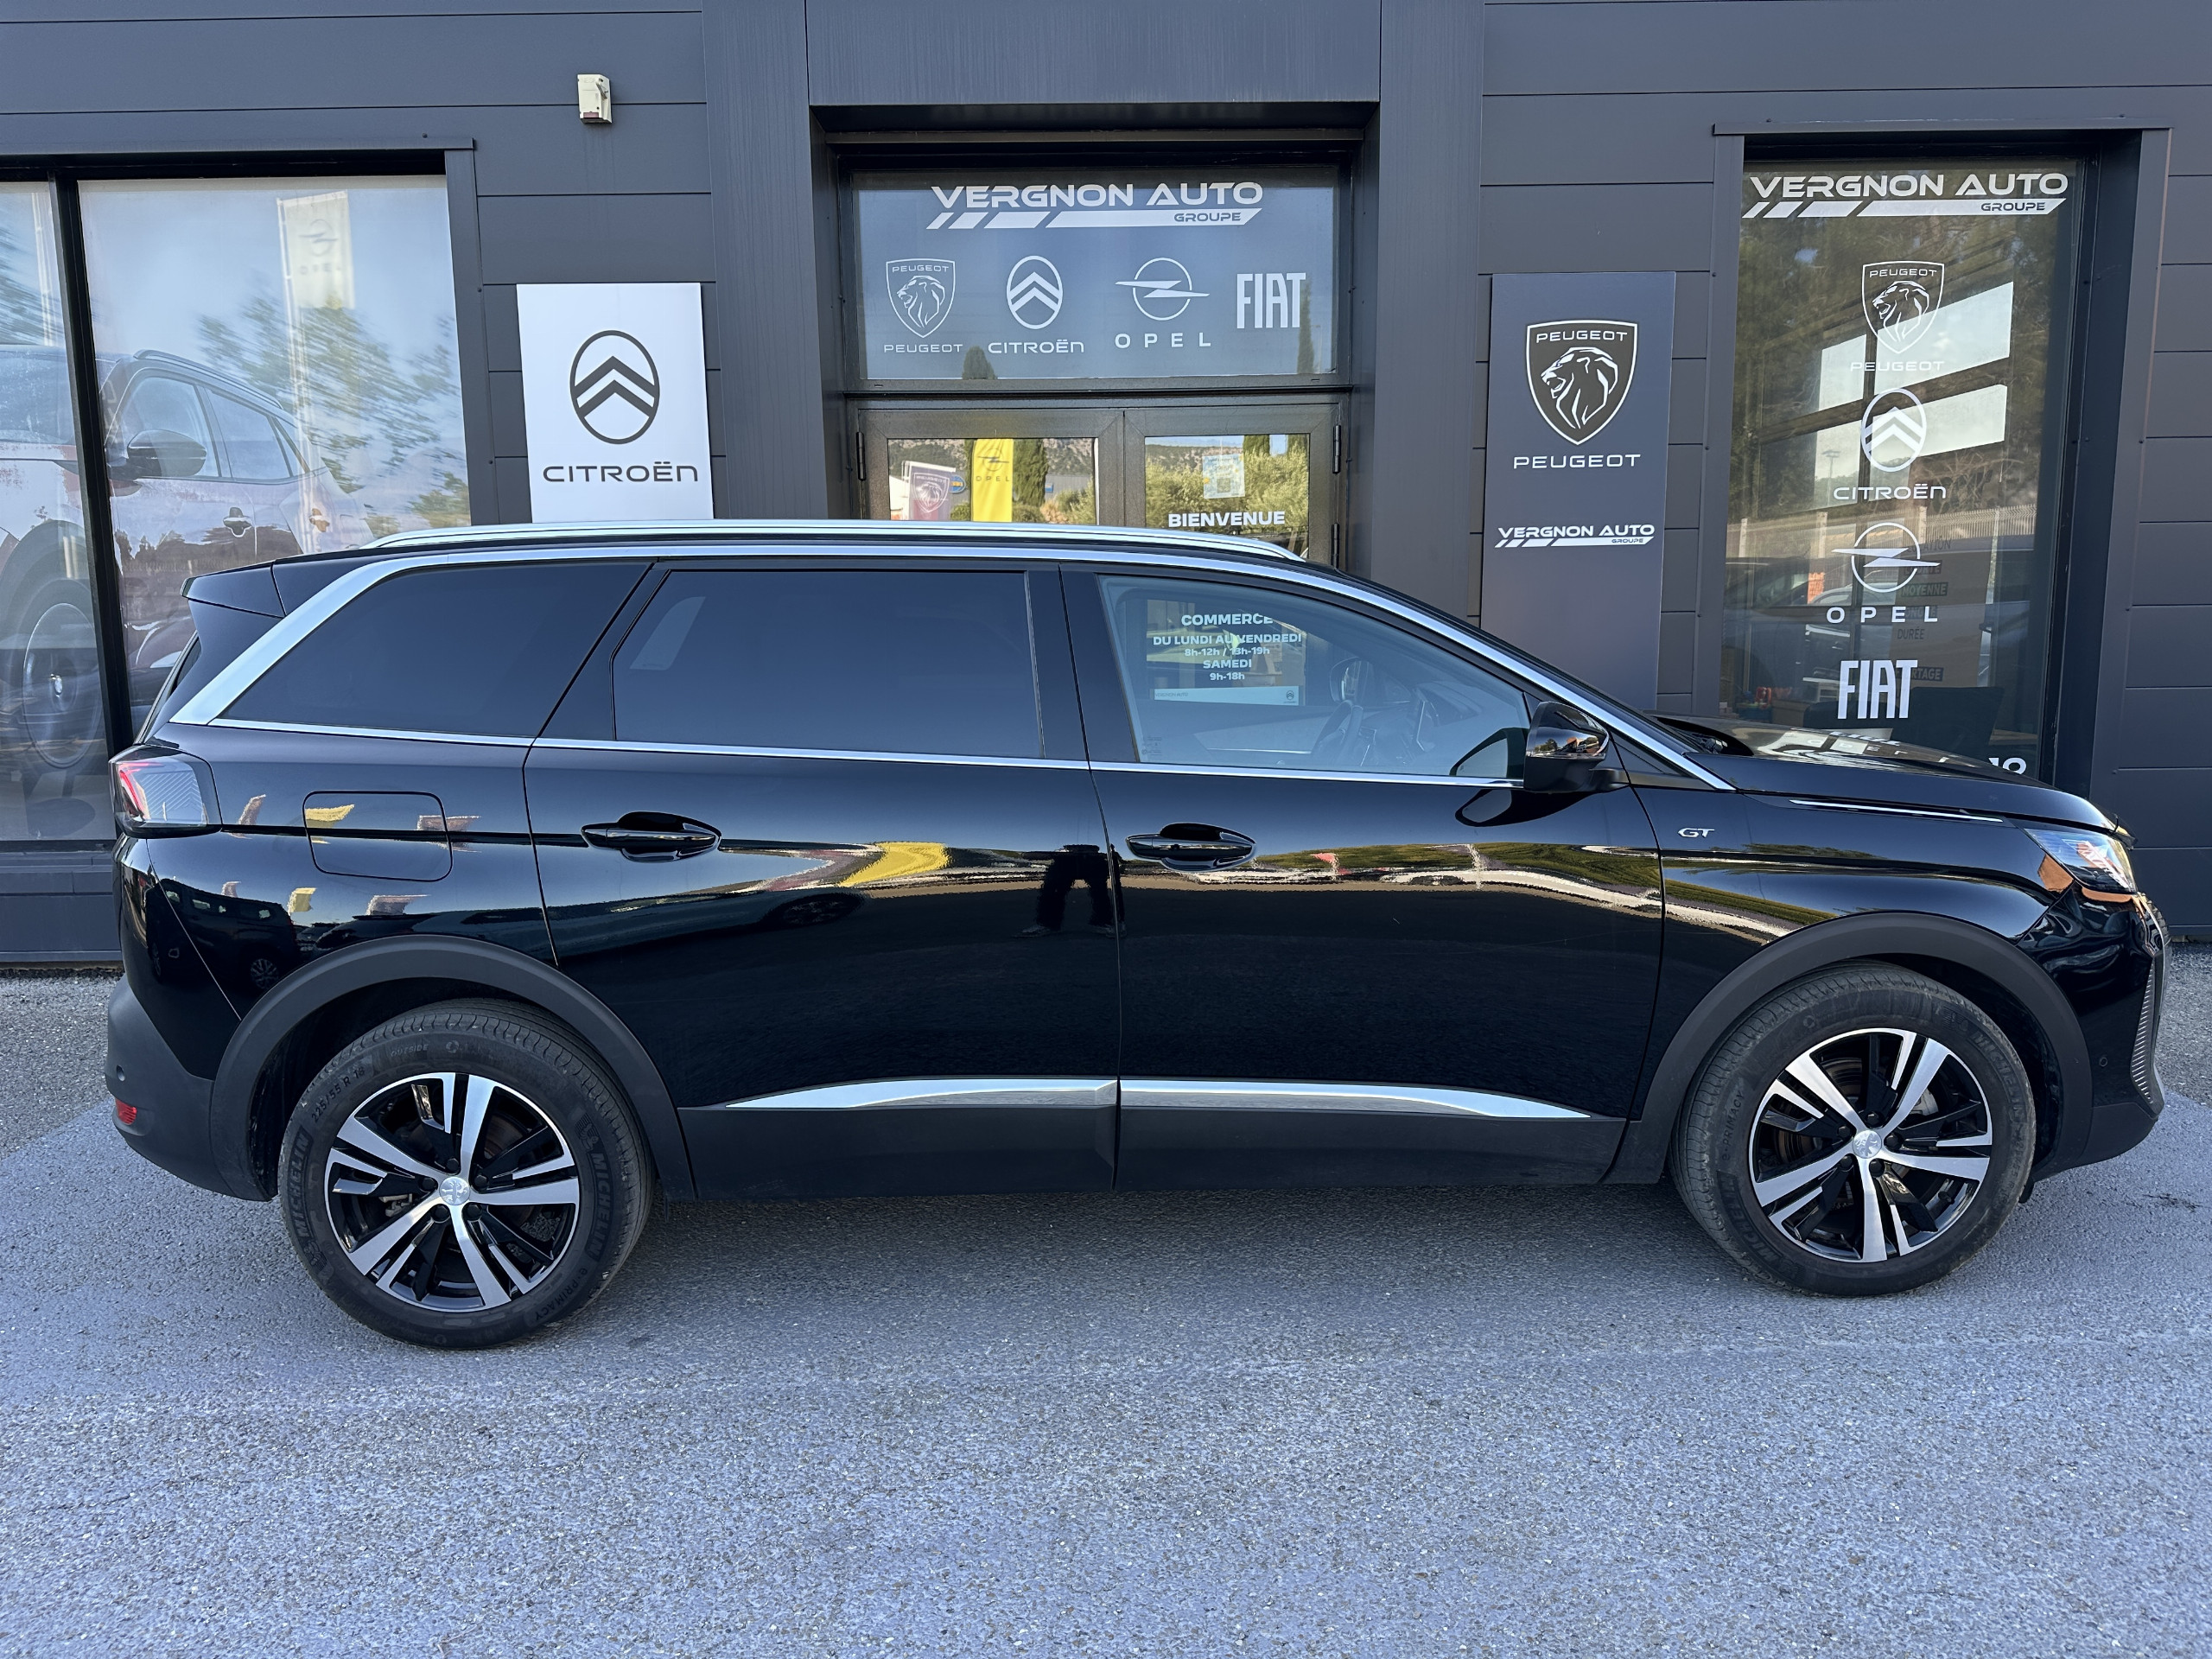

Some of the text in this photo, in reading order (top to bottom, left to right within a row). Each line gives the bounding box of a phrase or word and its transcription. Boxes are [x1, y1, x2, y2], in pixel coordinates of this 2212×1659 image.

[1750, 173, 2069, 199] VERGNON AUTO
[931, 182, 1263, 208] VERGNON AUTO
[1980, 201, 2046, 212] GROUPE
[1173, 212, 1242, 222] GROUPE
[892, 264, 950, 274] PEUGEOT
[1869, 268, 1937, 277] PEUGEOT
[1236, 272, 1306, 329] FIAT
[1115, 332, 1211, 349] OPEL
[1536, 330, 1628, 343] PEUGEOT
[883, 344, 963, 353] PEUGEOT
[988, 339, 1084, 353] CITROËN
[1850, 360, 1945, 372] PEUGEOT
[1513, 454, 1641, 469] PEUGEOT
[543, 461, 698, 482] CITROËN
[1833, 483, 1947, 500] CITROËN
[1168, 511, 1286, 528] BIENVENUE
[1497, 524, 1656, 538] VERGNON AUTO
[1902, 583, 1947, 596] MOYENNE
[1826, 606, 1938, 624] OPEL
[1153, 633, 1302, 645] DU LUNDI AU VENDREDI
[1897, 626, 1925, 639] DURÉE
[1185, 648, 1220, 657] 8h-12h
[1230, 646, 1270, 657] 13h-19h
[1203, 659, 1252, 669] SAMEDI
[1209, 671, 1245, 681] 9h-18h
[1837, 659, 1918, 719] FIAT
[1677, 827, 1715, 838] GT
[311, 1084, 342, 1123] 225/55
[289, 1130, 311, 1238] MICHELIN
[588, 1152, 613, 1256] MICHELIN
